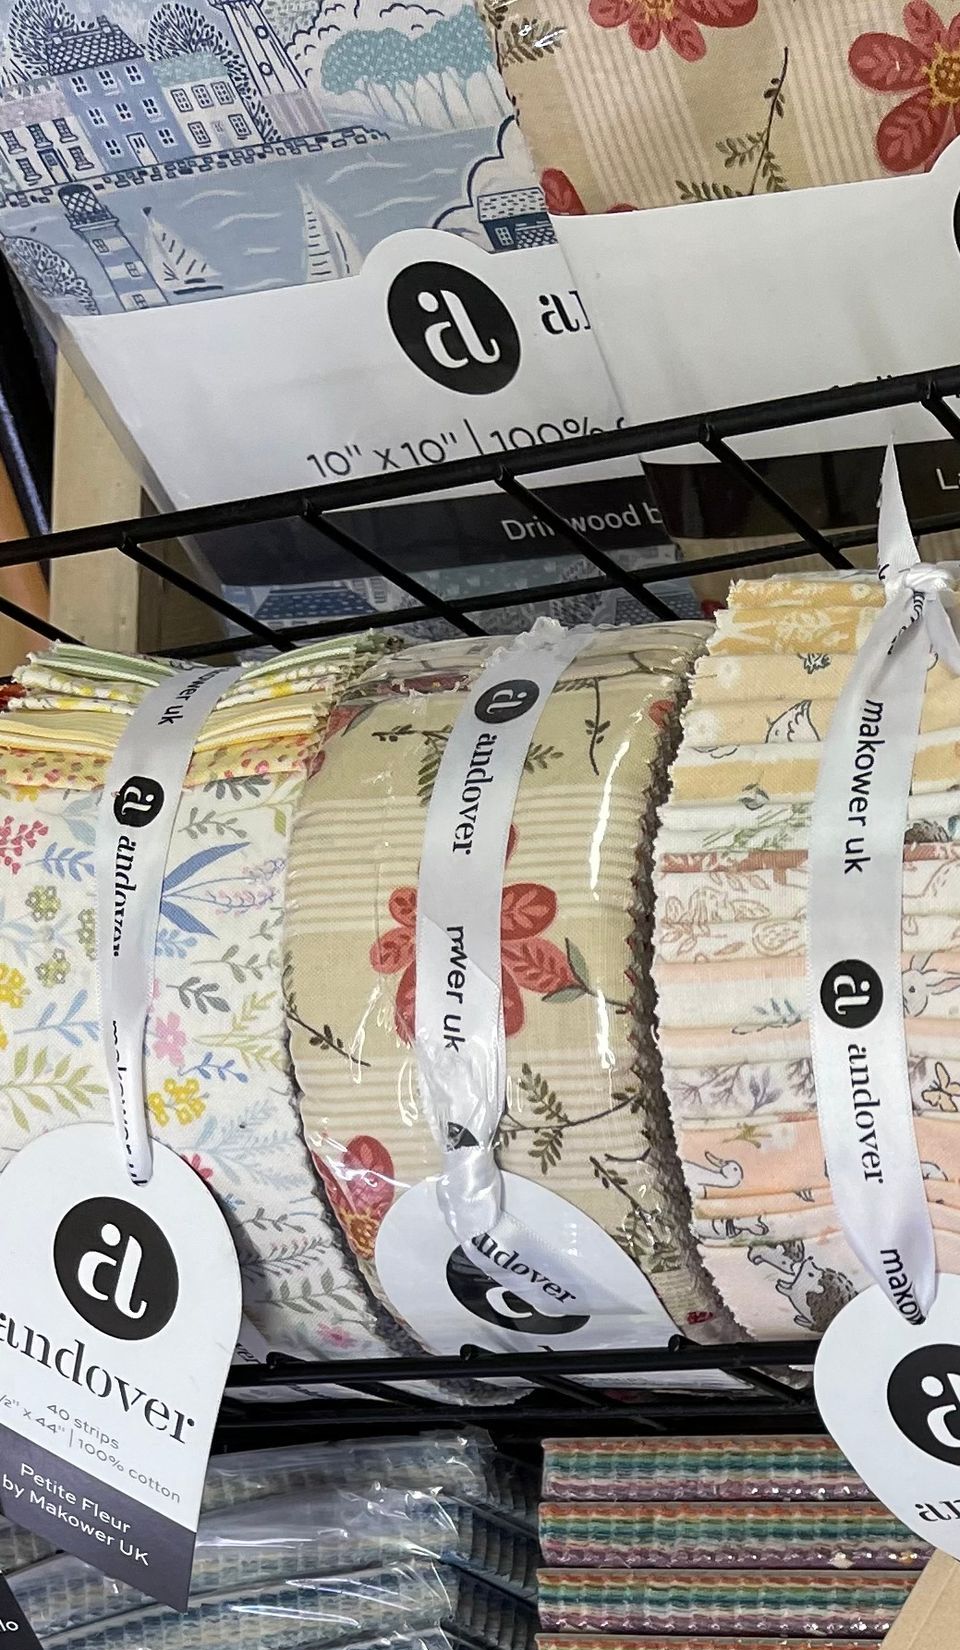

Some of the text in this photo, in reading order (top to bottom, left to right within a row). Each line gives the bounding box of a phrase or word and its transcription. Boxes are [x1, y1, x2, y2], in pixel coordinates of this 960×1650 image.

[307, 443, 361, 478] 10"
[373, 447, 401, 471] x
[400, 432, 458, 466] 10"
[158, 704, 184, 726] uk
[452, 732, 498, 856] andover
[844, 699, 886, 876] makower uk
[442, 1013, 467, 1053] uk
[847, 1043, 885, 1184] andover
[0, 1312, 195, 1445] andover
[33, 1416, 66, 1435] 44"
[77, 1437, 125, 1473] 100%
[128, 1467, 181, 1504] cotton
[47, 1402, 120, 1450] 40 strips
[2, 1473, 150, 1567] by Makower UK
[20, 1462, 132, 1534] Petite Fleur
